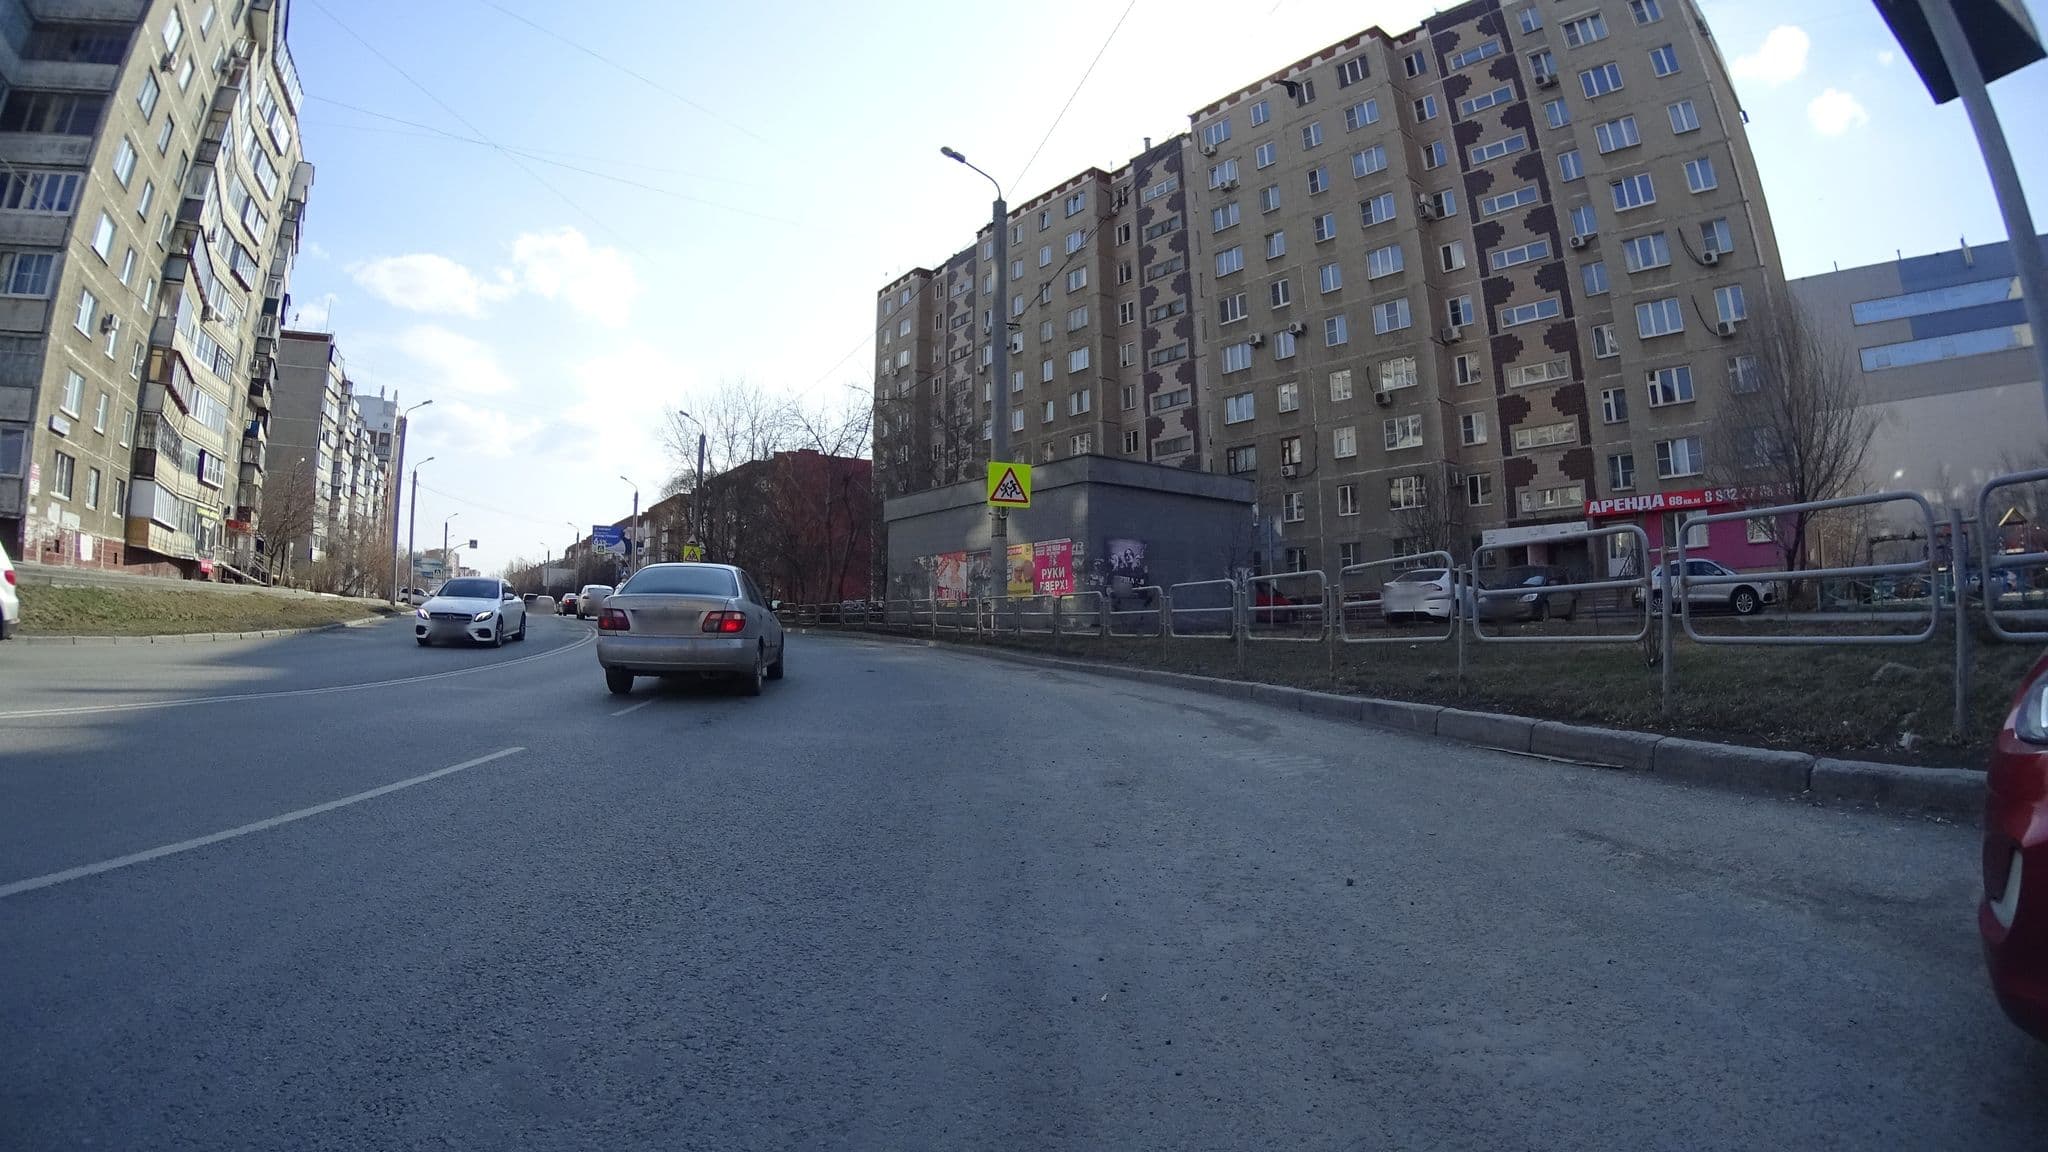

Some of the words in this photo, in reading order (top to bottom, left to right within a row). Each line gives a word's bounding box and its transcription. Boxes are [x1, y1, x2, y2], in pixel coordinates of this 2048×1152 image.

[1588, 494, 1665, 514] АРЕНДА
[1704, 490, 1713, 503] 8
[1041, 567, 1065, 580] РУКИ
